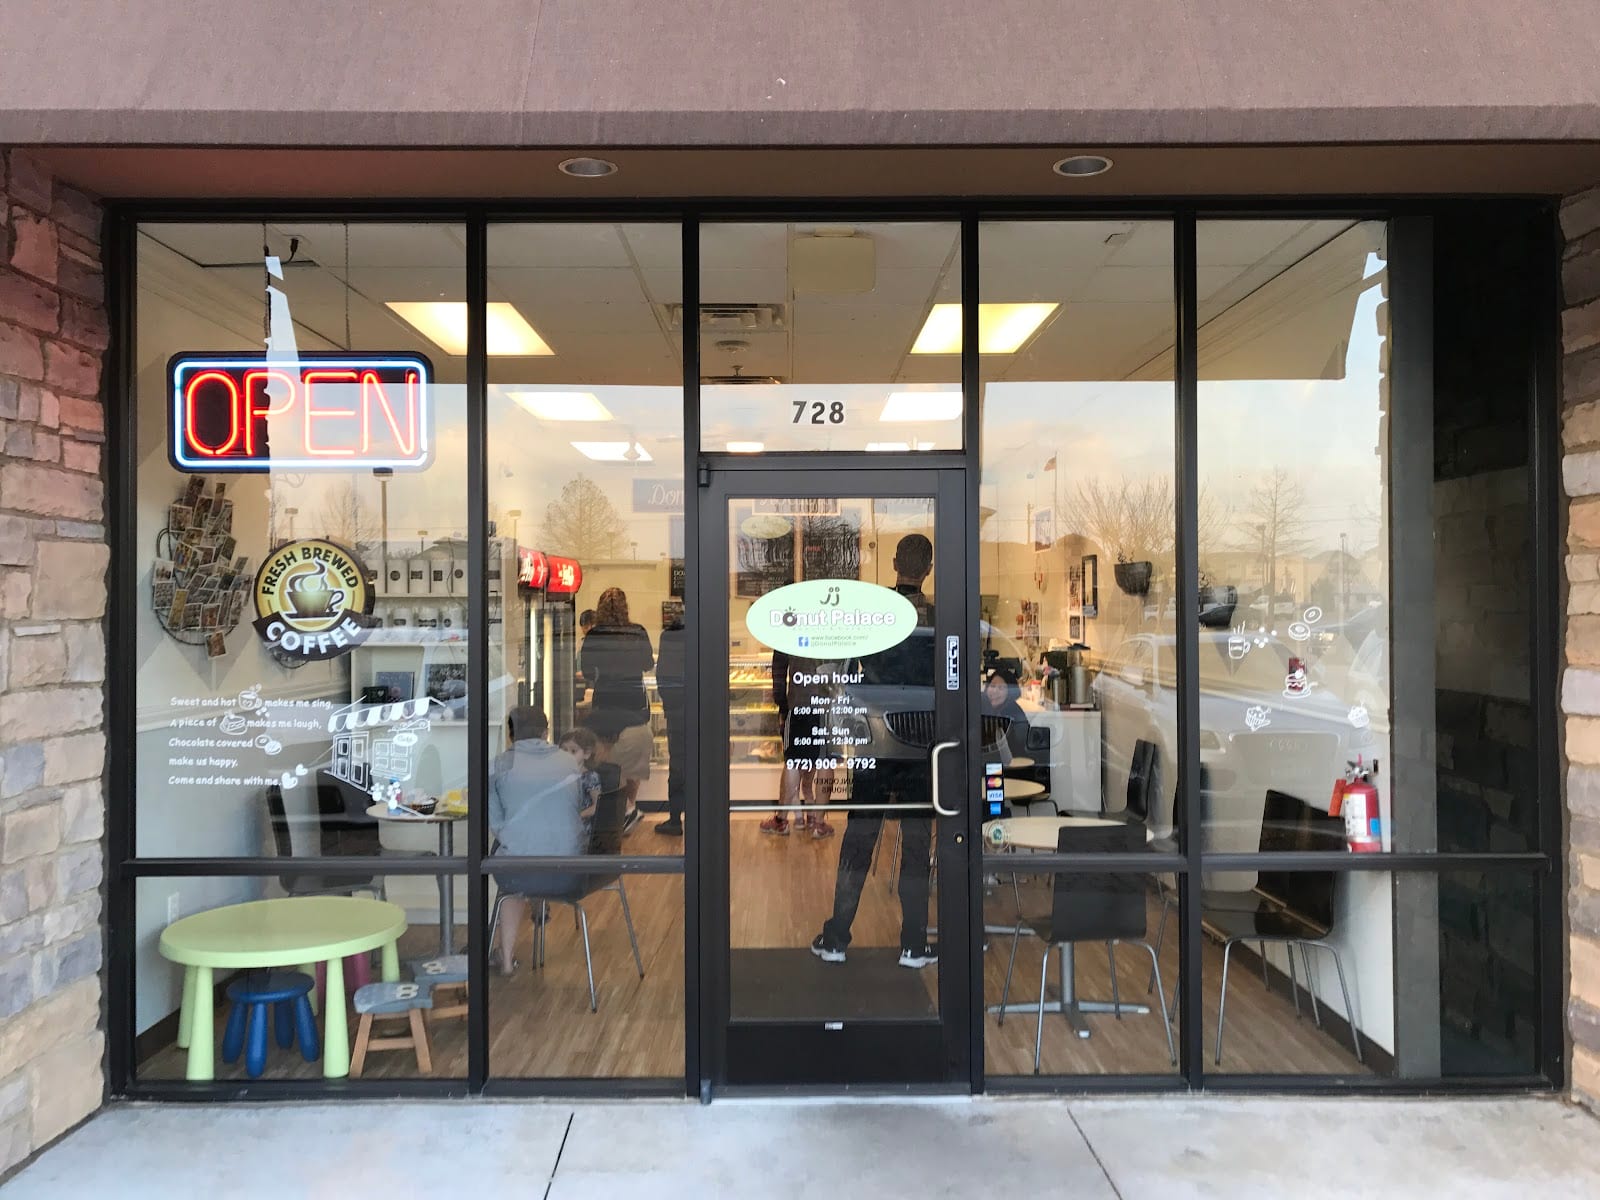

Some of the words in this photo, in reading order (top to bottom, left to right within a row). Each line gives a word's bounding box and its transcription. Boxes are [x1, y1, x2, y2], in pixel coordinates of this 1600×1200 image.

[185, 369, 417, 456] OPEN
[792, 400, 845, 425] 728
[262, 551, 298, 595] FRESH
[301, 547, 359, 589] BREWED
[769, 607, 827, 627] Donut
[830, 609, 896, 627] Palace
[266, 617, 362, 655] COFFEE
[949, 639, 958, 677] PULL
[792, 671, 829, 687] Open
[832, 671, 865, 684] hour
[170, 697, 200, 706] Sweet
[201, 697, 219, 706] and
[220, 697, 237, 706] hot
[264, 698, 294, 707] makes
[296, 700, 310, 708] me
[311, 699, 334, 711] sing,
[810, 695, 830, 705] Mon
[837, 695, 850, 705] Fri
[831, 706, 853, 715] 12:00
[854, 708, 868, 717] pm
[169, 719, 177, 727] A
[178, 717, 205, 728] piece
[206, 718, 217, 727] of
[247, 718, 276, 728] makes
[278, 720, 292, 728] me
[294, 719, 323, 730] laugh,
[811, 726, 830, 736] Sat.
[831, 726, 850, 736] Sun
[168, 737, 215, 748] Chocolate
[216, 738, 253, 748] covered
[854, 738, 868, 747] pm
[168, 756, 194, 766] make
[196, 758, 208, 766] us
[208, 757, 239, 769] happy.
[786, 758, 812, 772] 972)
[815, 758, 837, 770] 906
[846, 757, 877, 770] 9792
[168, 776, 194, 785] Come
[195, 776, 213, 785] and
[214, 776, 241, 786] share
[243, 776, 263, 786] with
[264, 778, 282, 786] me.
